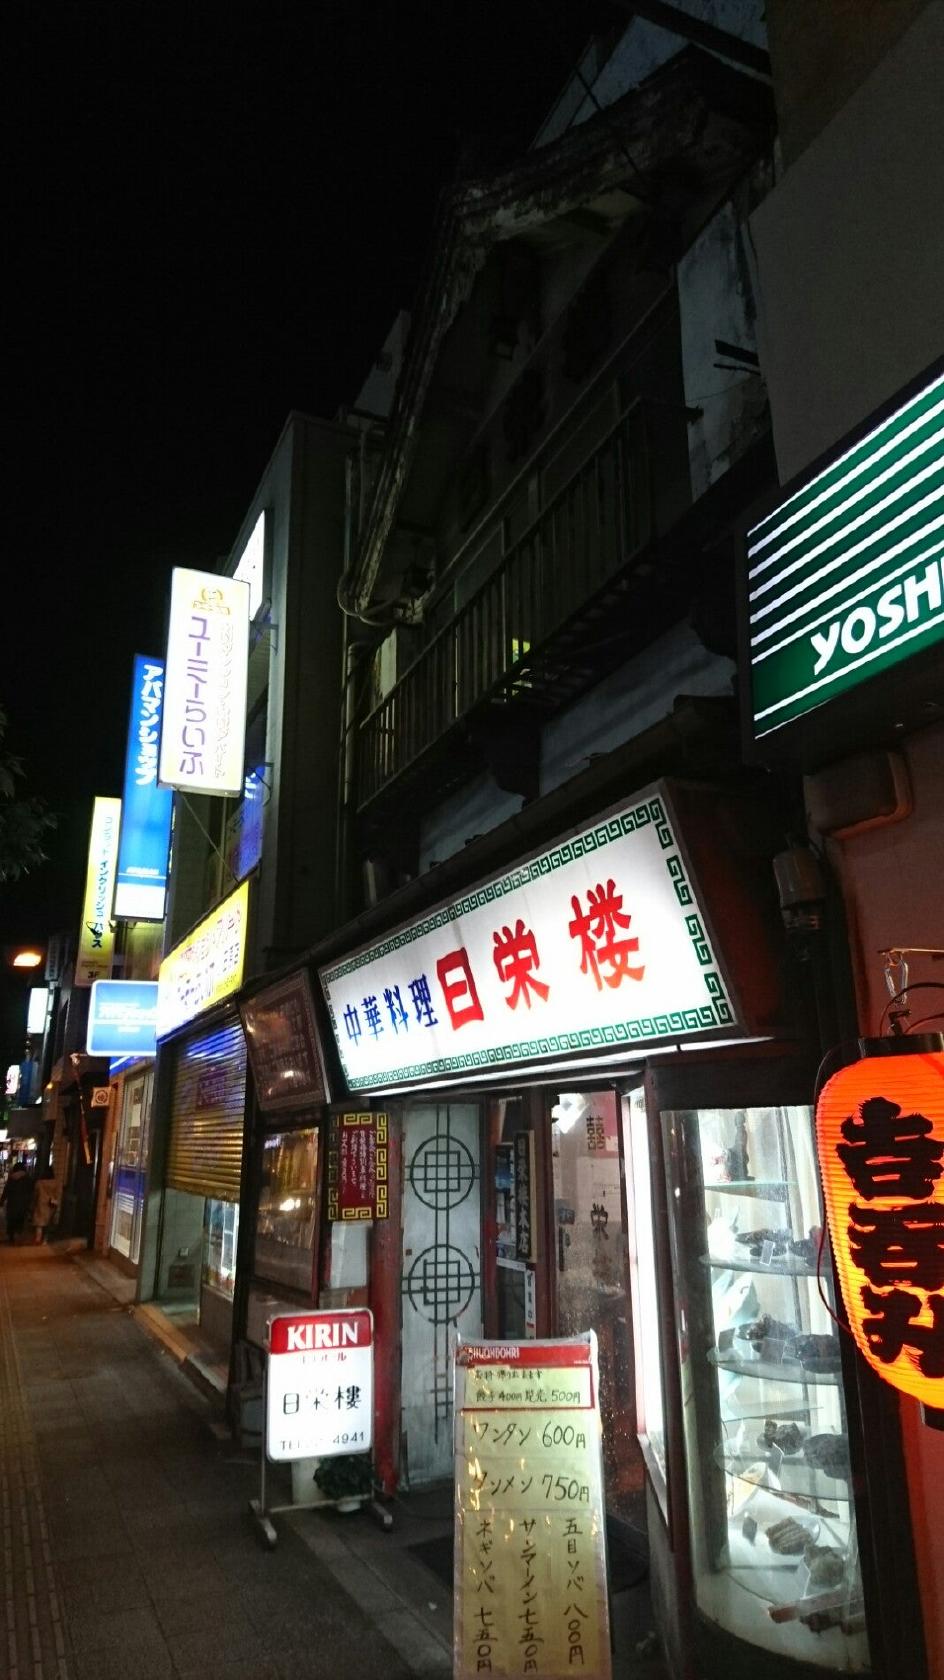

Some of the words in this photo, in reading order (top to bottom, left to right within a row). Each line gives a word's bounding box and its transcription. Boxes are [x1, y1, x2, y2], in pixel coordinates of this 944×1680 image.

[811, 556, 944, 676] YOSH
[179, 616, 210, 775] ユーミーらいふ
[343, 973, 438, 1046] 中華料理
[435, 878, 645, 1031] 日栄楼
[287, 1322, 359, 1351] KIRIN
[473, 1422, 532, 1446] ワンタン
[542, 1420, 586, 1449] 600円
[541, 1473, 590, 1503] 750円
[476, 1519, 496, 1593] ネギソバ
[519, 1518, 538, 1604] サンマーメン
[562, 1517, 584, 1592] 五目ソバ
